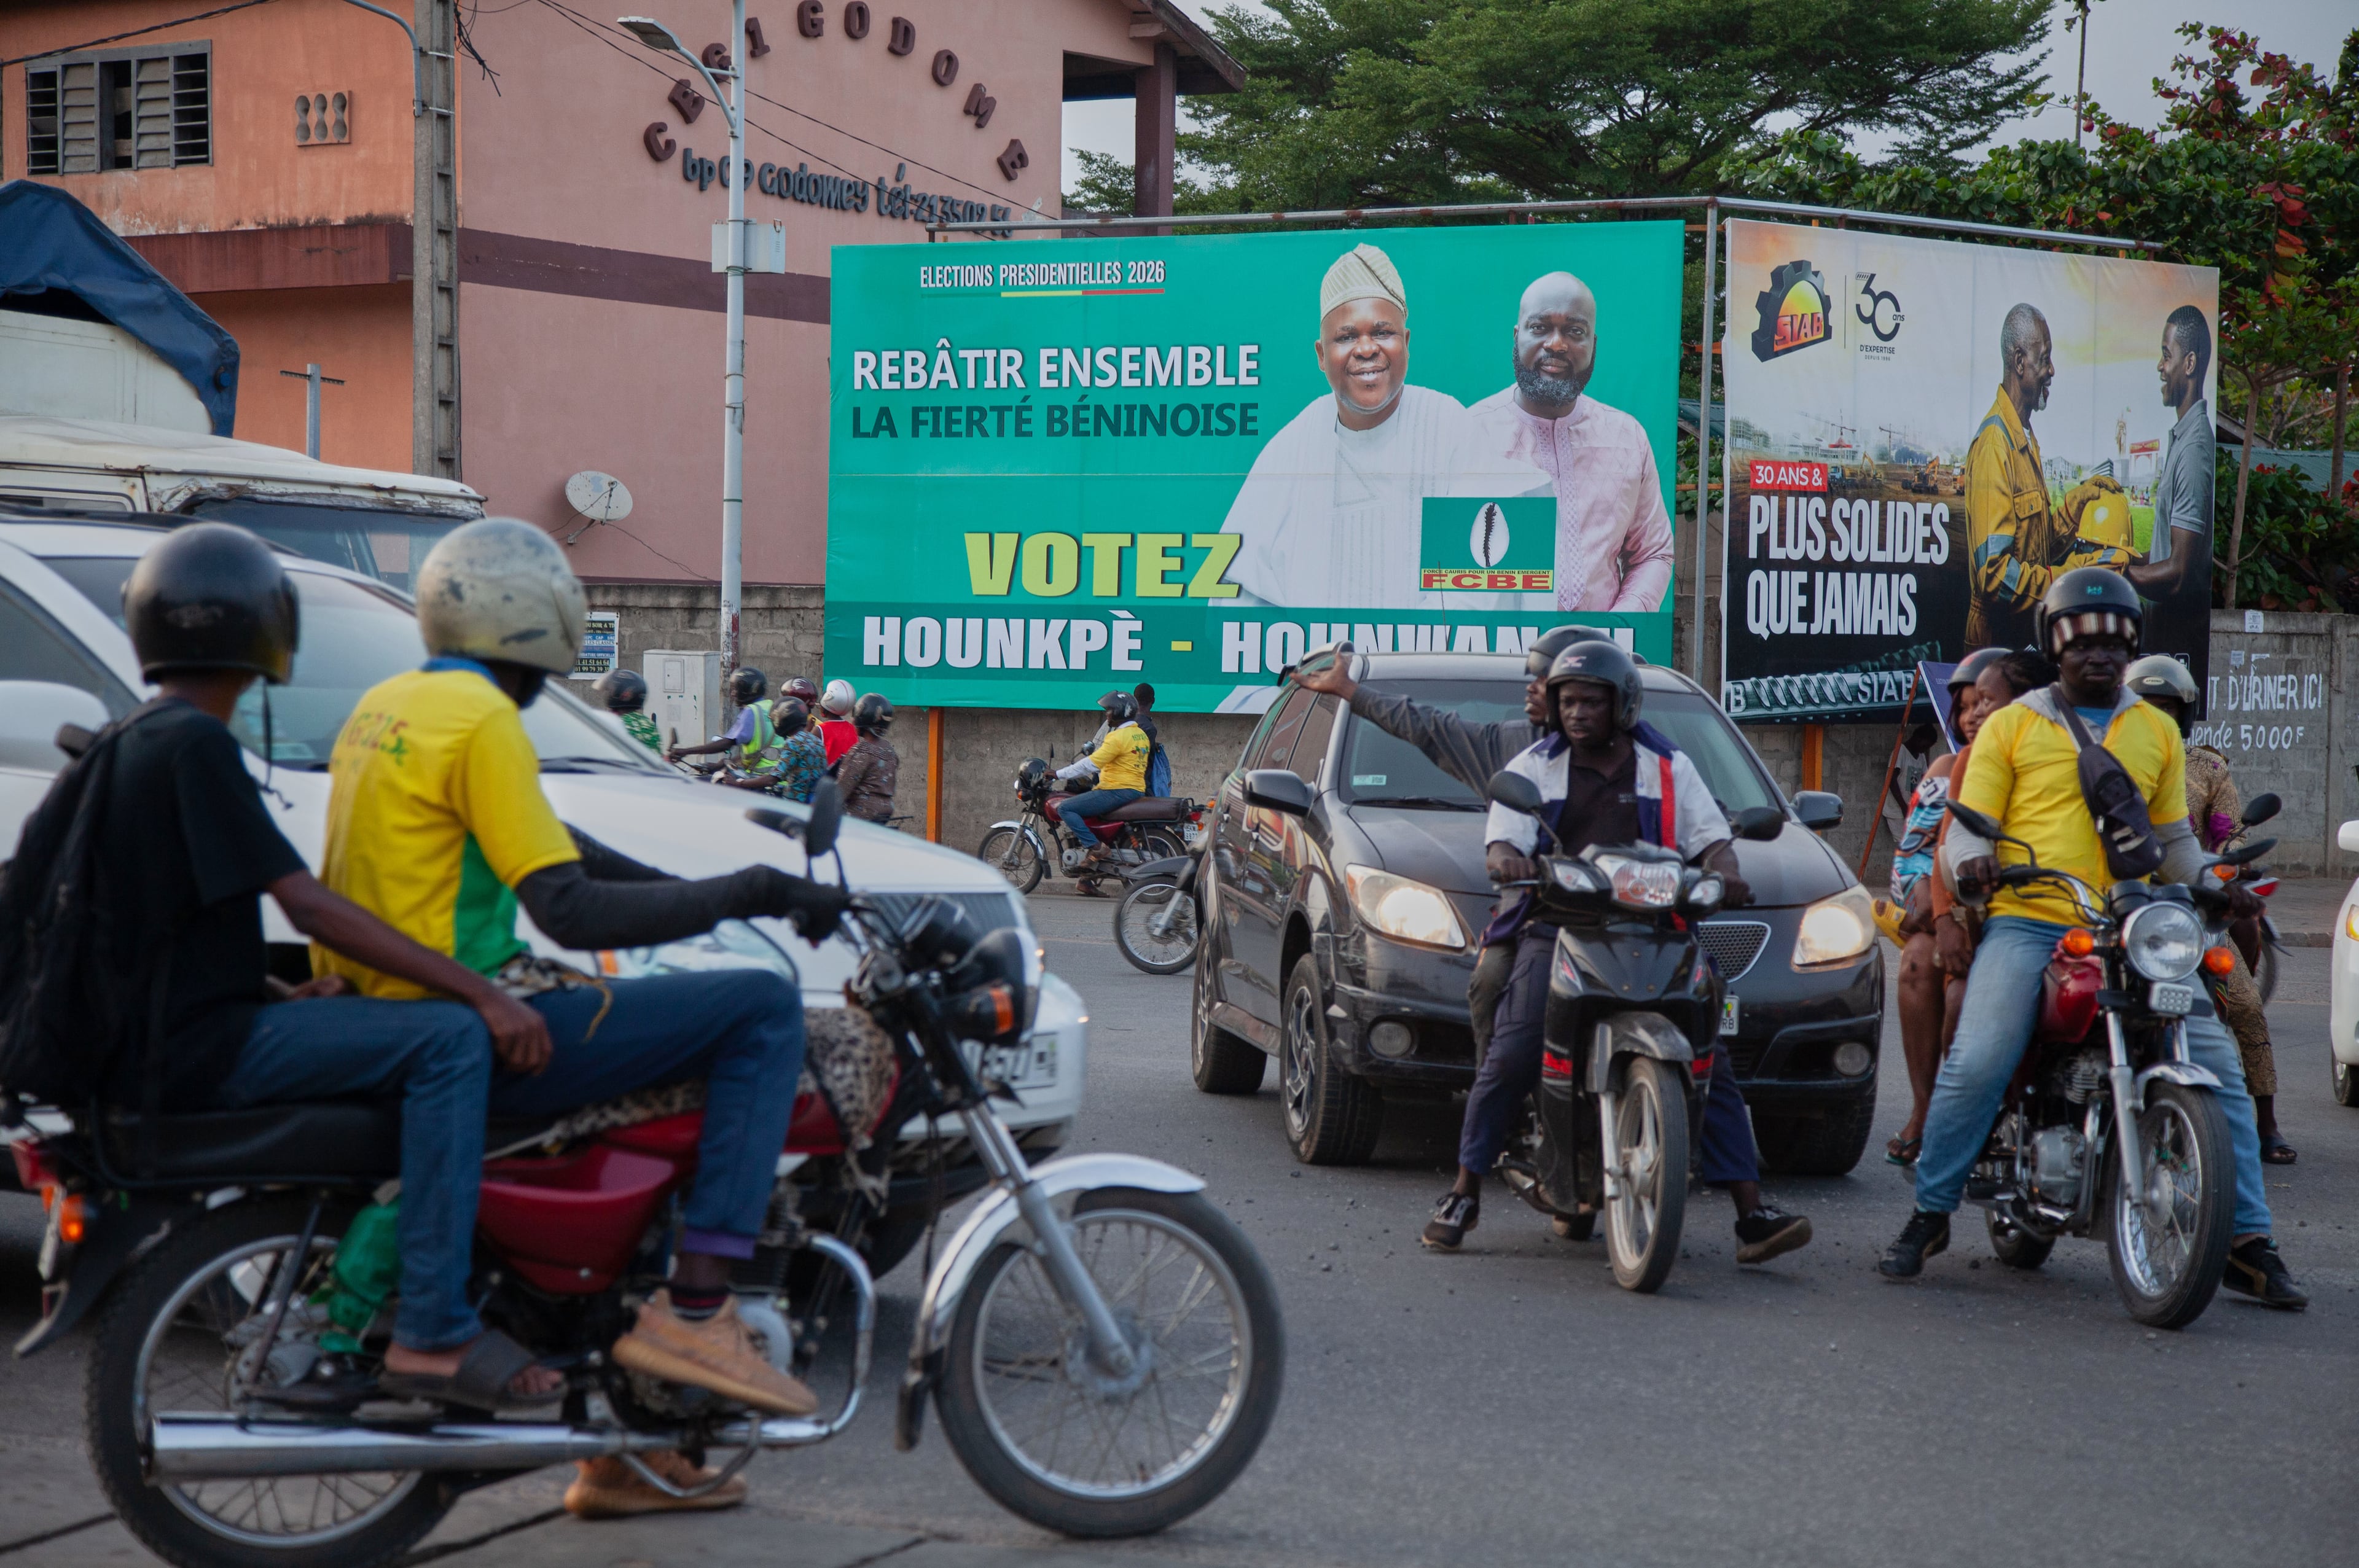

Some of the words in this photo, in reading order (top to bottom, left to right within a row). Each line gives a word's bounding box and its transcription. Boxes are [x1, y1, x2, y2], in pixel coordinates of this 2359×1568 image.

[683, 147, 716, 191] bp
[920, 265, 993, 288] ELECTIONS
[1000, 262, 1122, 286] PRESIDENTIELLES
[1127, 260, 1166, 283] 2026
[1775, 312, 1824, 346] SIAB
[1892, 313, 1905, 322] ans
[854, 338, 1024, 390] REBÂTIR
[1039, 345, 1259, 388] ENSEMBLE
[1860, 344, 1895, 354] D'EXPERTISE
[852, 406, 898, 438] LA
[911, 395, 1033, 438] FIERTÉ
[1046, 394, 1259, 437] BÉNINOISE
[1755, 465, 1774, 485] 30
[1777, 466, 1809, 486] ANS
[1812, 468, 1822, 486] &
[1748, 495, 1826, 561] PLUS
[1830, 497, 1949, 565] SOLIDES
[964, 532, 1241, 598] VOTEZ
[1423, 574, 1550, 590] FCBE
[1747, 569, 1807, 641] QUE
[1810, 572, 1917, 636] JAMAIS
[863, 609, 1143, 671] HOUNKPÈ
[1858, 671, 1916, 704] SIAB
[2303, 673, 2322, 710] ICI
